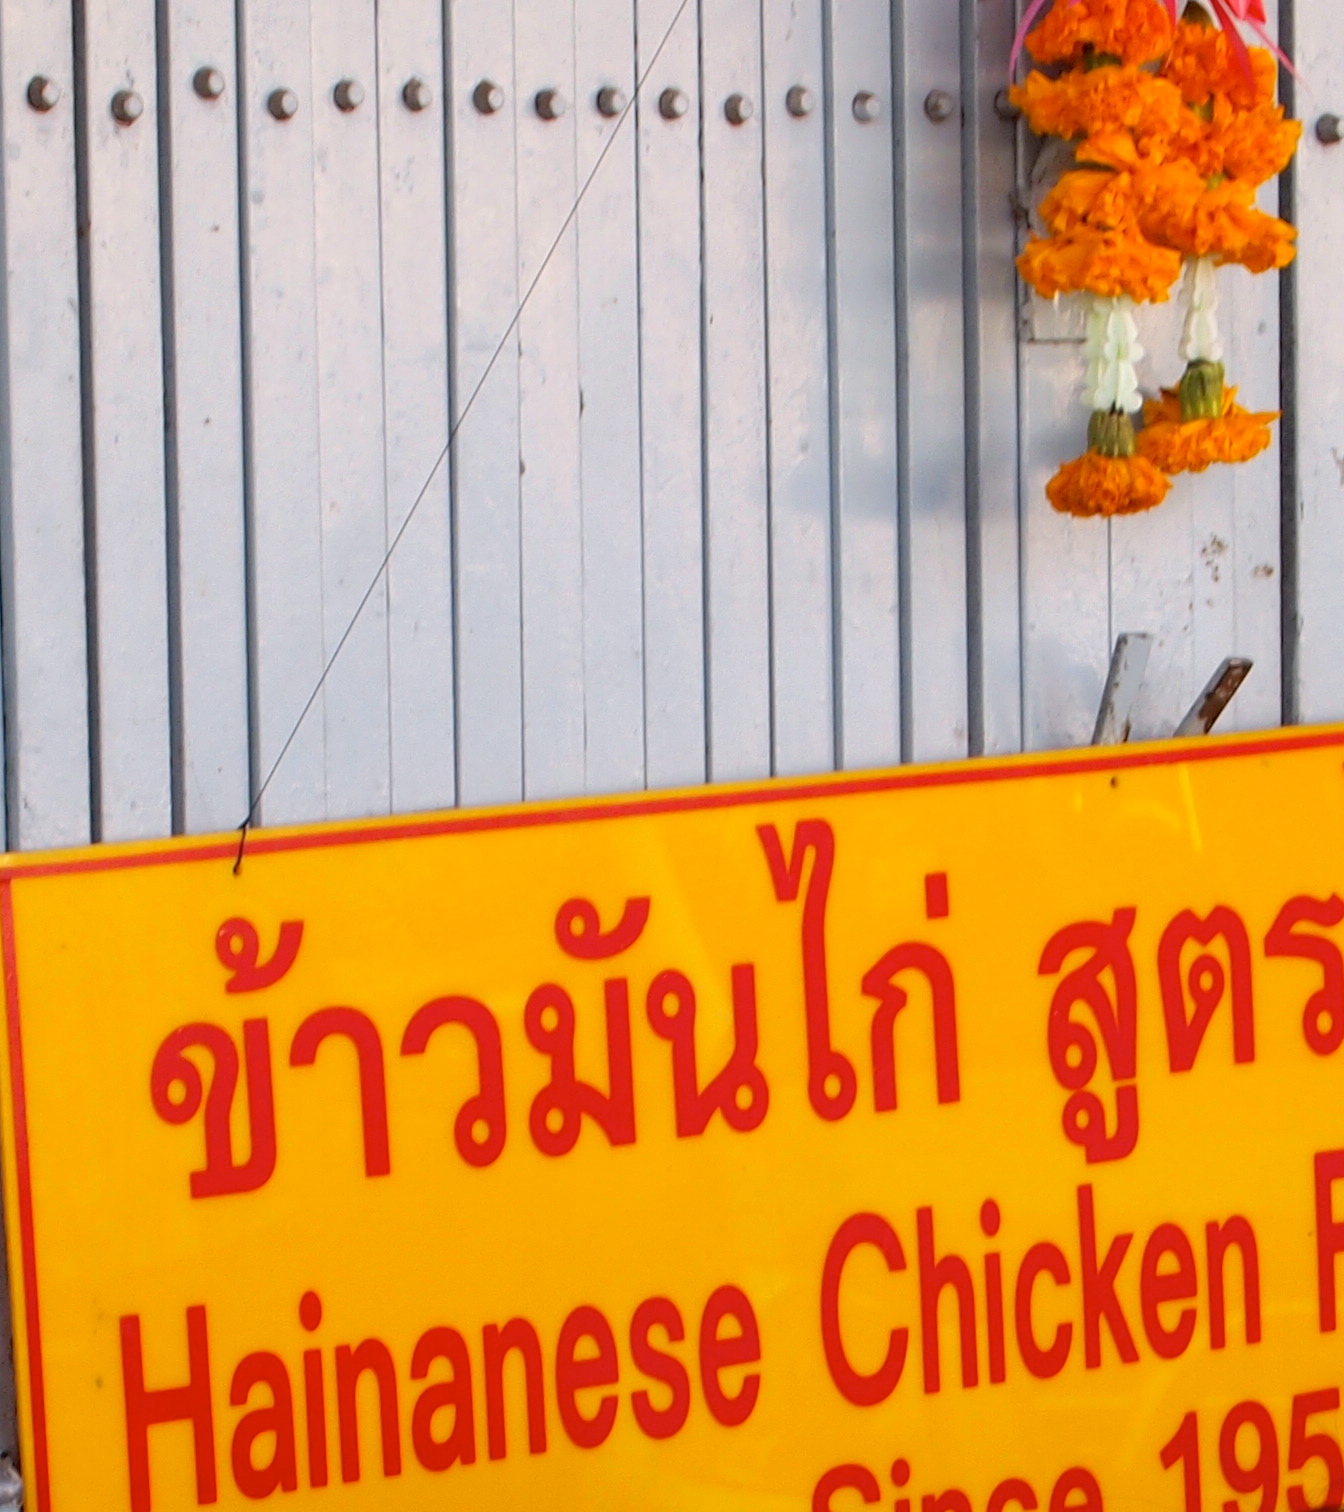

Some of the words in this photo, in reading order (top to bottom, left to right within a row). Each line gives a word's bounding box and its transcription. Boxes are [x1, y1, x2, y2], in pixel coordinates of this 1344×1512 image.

[150, 817, 962, 1200] ข้าวมันไก่
[819, 1182, 1264, 1409] Chicken
